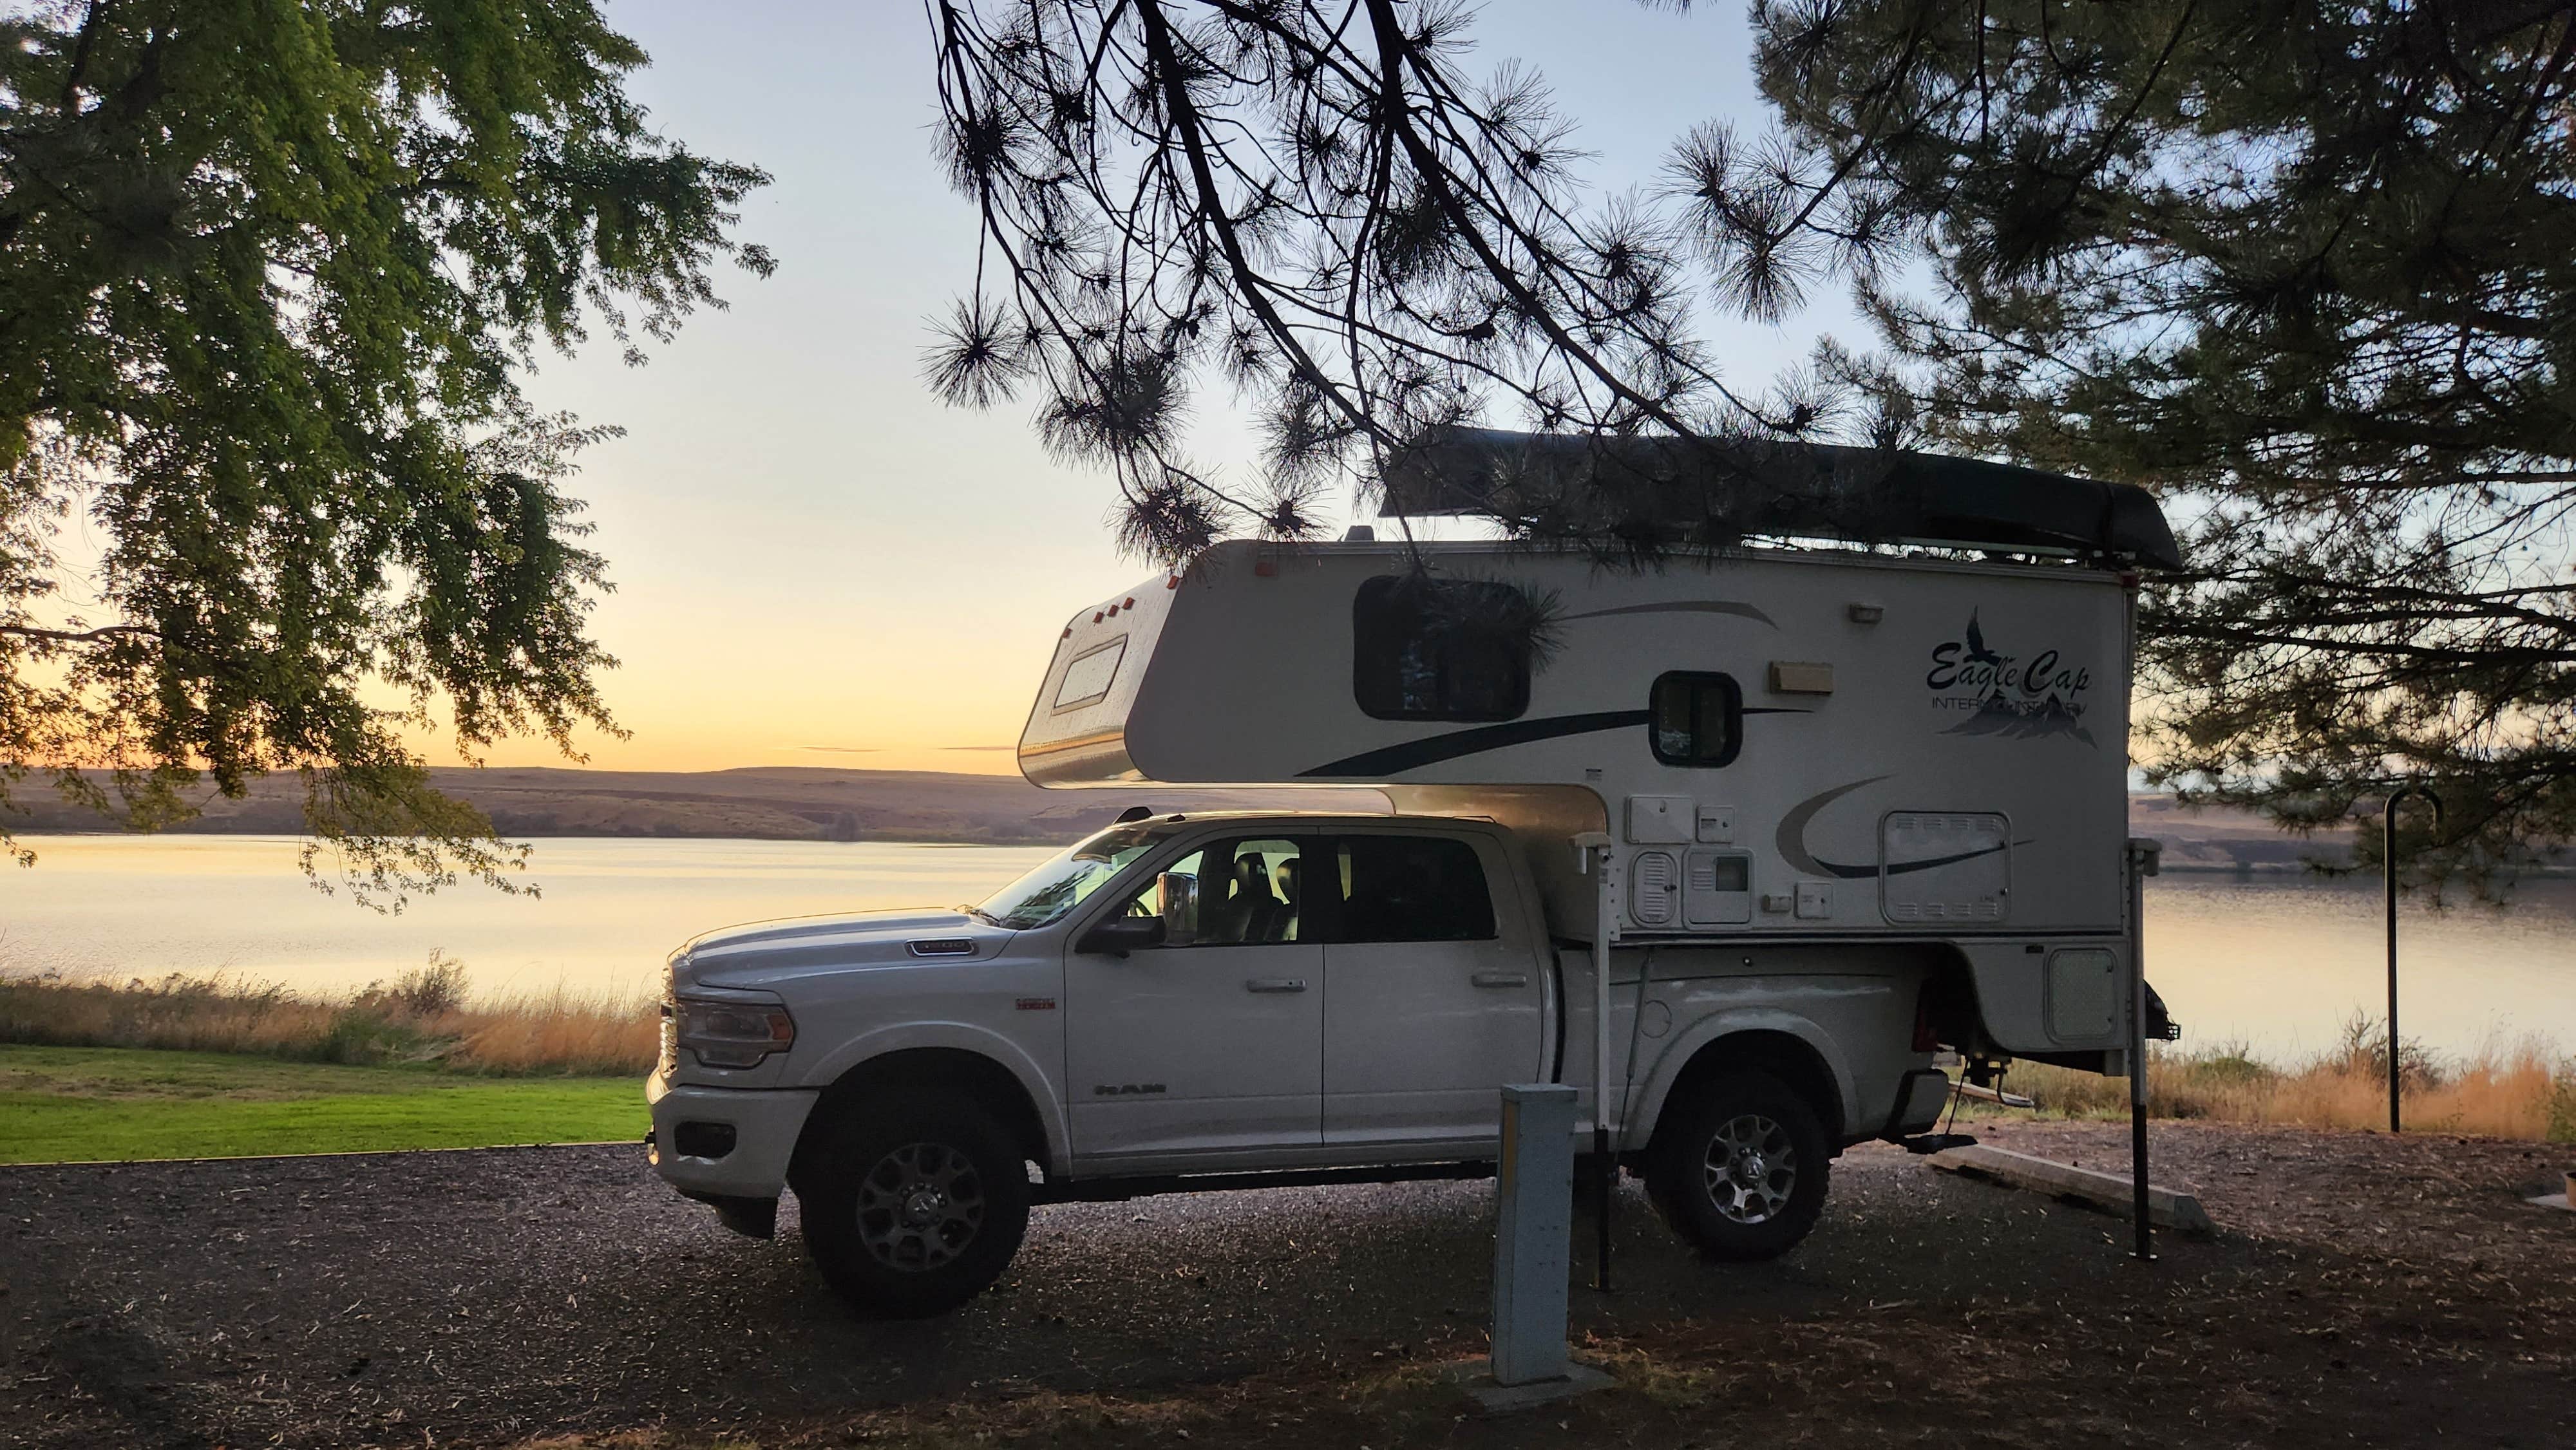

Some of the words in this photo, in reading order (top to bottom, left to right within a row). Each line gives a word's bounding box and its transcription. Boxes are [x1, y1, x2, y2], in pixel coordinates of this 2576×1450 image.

[1927, 642, 2018, 697] Eagle
[2023, 649, 2092, 699] Cap
[1094, 1083, 1167, 1095] RAM
